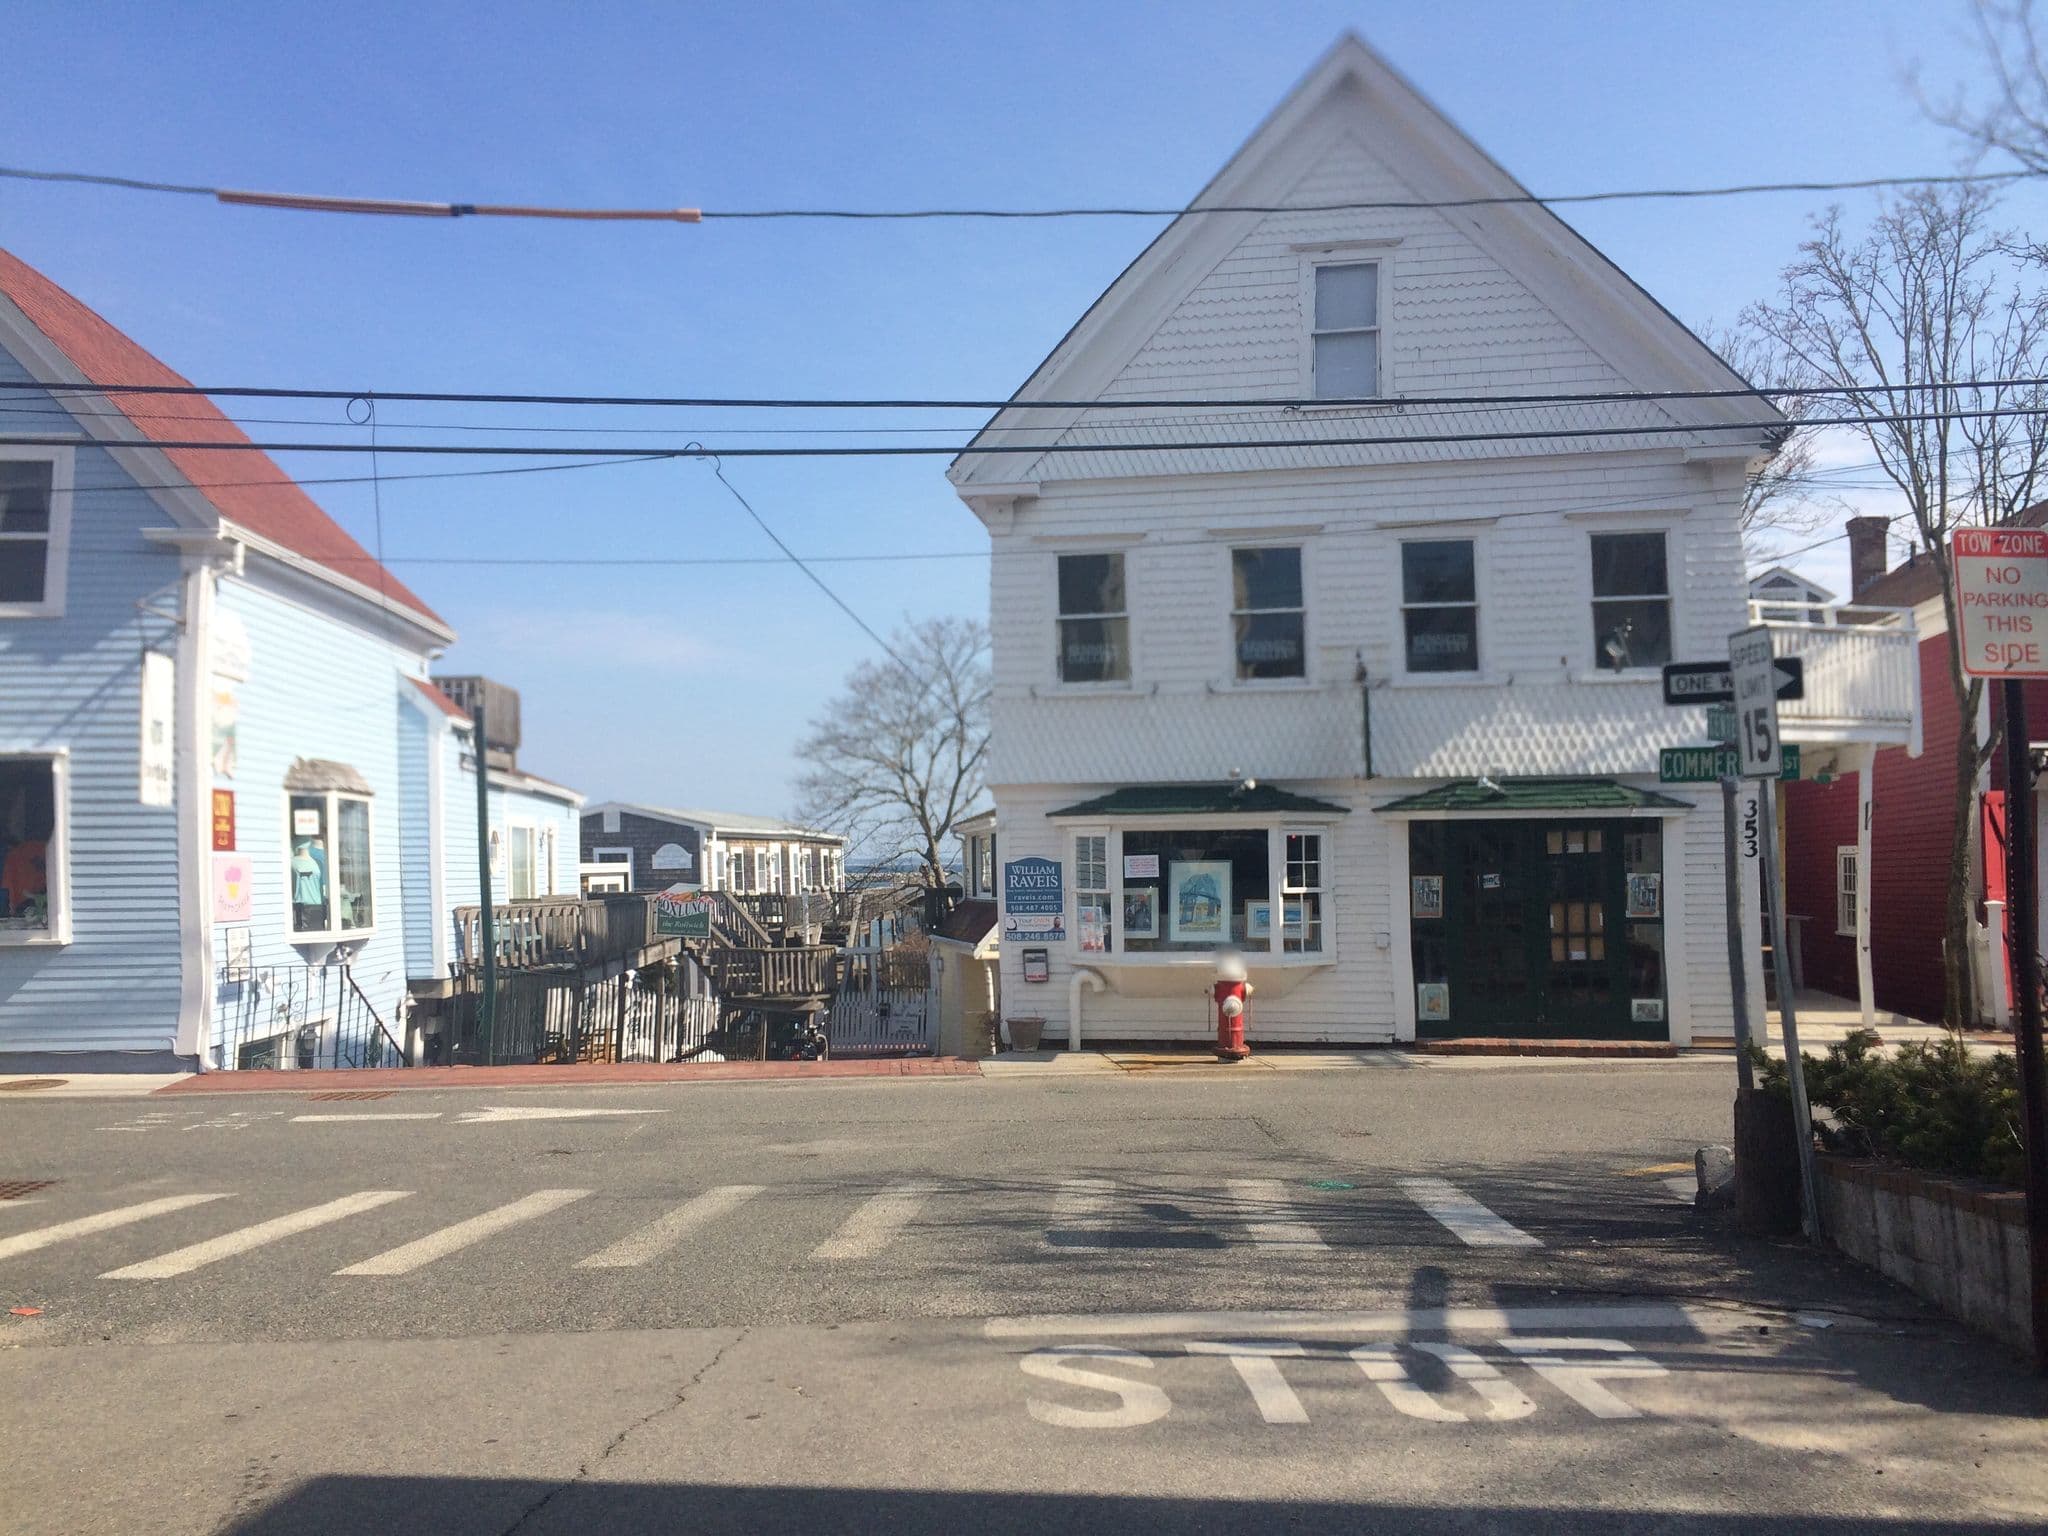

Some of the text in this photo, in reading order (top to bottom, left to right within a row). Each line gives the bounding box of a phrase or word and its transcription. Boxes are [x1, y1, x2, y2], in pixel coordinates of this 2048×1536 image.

[1959, 533, 2045, 553] TOW ZONE
[1985, 566, 2021, 584] NO
[1963, 592, 2048, 608] PARKING
[1984, 615, 2033, 632] THIS
[1731, 641, 1769, 669] SPEED
[1985, 643, 2041, 663] SIDE
[1676, 673, 1712, 692] ONE
[1740, 674, 1768, 699] LIMIT
[1744, 707, 1772, 763] 15
[1660, 751, 1799, 778] COMMER ST
[1744, 799, 1758, 858] 353
[1012, 865, 1055, 875] WILLIAM
[1009, 875, 1058, 888] RAVEIS
[1017, 1336, 1670, 1429] STOP
